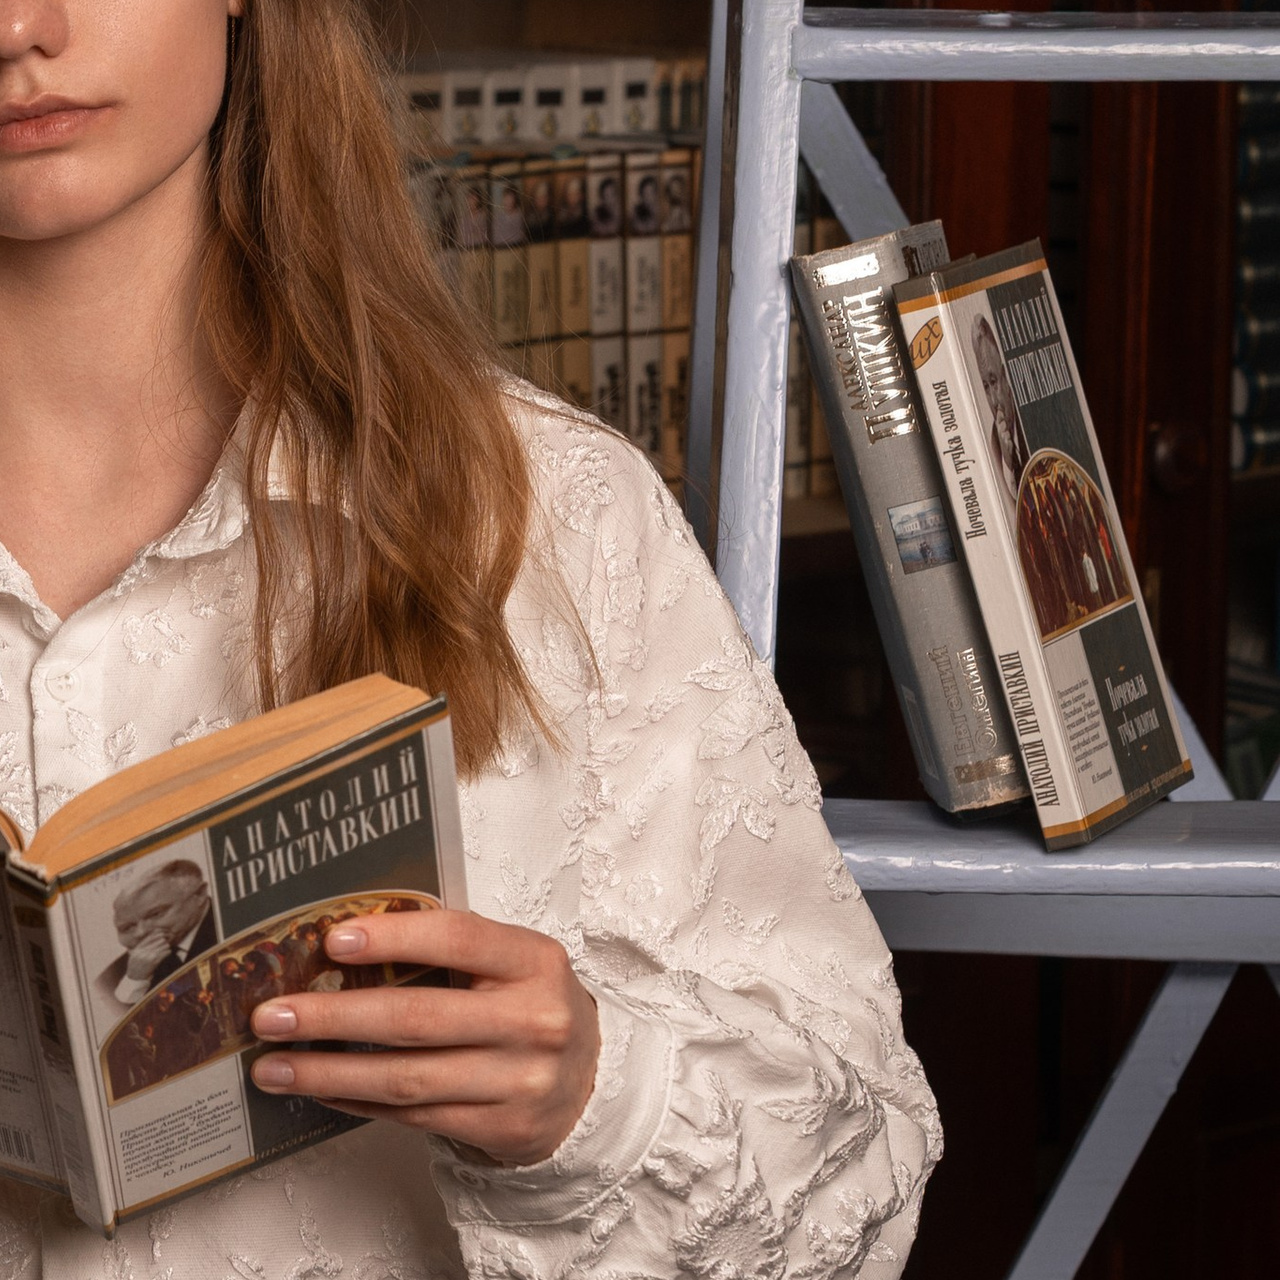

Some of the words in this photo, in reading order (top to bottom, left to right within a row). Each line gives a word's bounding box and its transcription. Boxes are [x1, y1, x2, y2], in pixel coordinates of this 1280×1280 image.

[996, 286, 1058, 352] АНАТОЛИЙ
[821, 299, 871, 411] АЛЕКСАНДР
[842, 285, 916, 447] ПУШКИН
[1007, 342, 1073, 407] ПРИСТАВКИН
[932, 380, 959, 433] золотая
[943, 435, 976, 475] тучка
[959, 477, 988, 540] Ночевала
[998, 650, 1041, 736] ПРИСТАВКИН
[1023, 738, 1060, 807] АНАТОЛИЙ
[221, 744, 418, 869] АНАТОЛИЙ
[223, 785, 424, 904] ПРИСТАВКИН
[159, 1104, 207, 1128] Анатолия
[206, 1087, 227, 1101] боли
[121, 1119, 185, 1152] Приставкина
